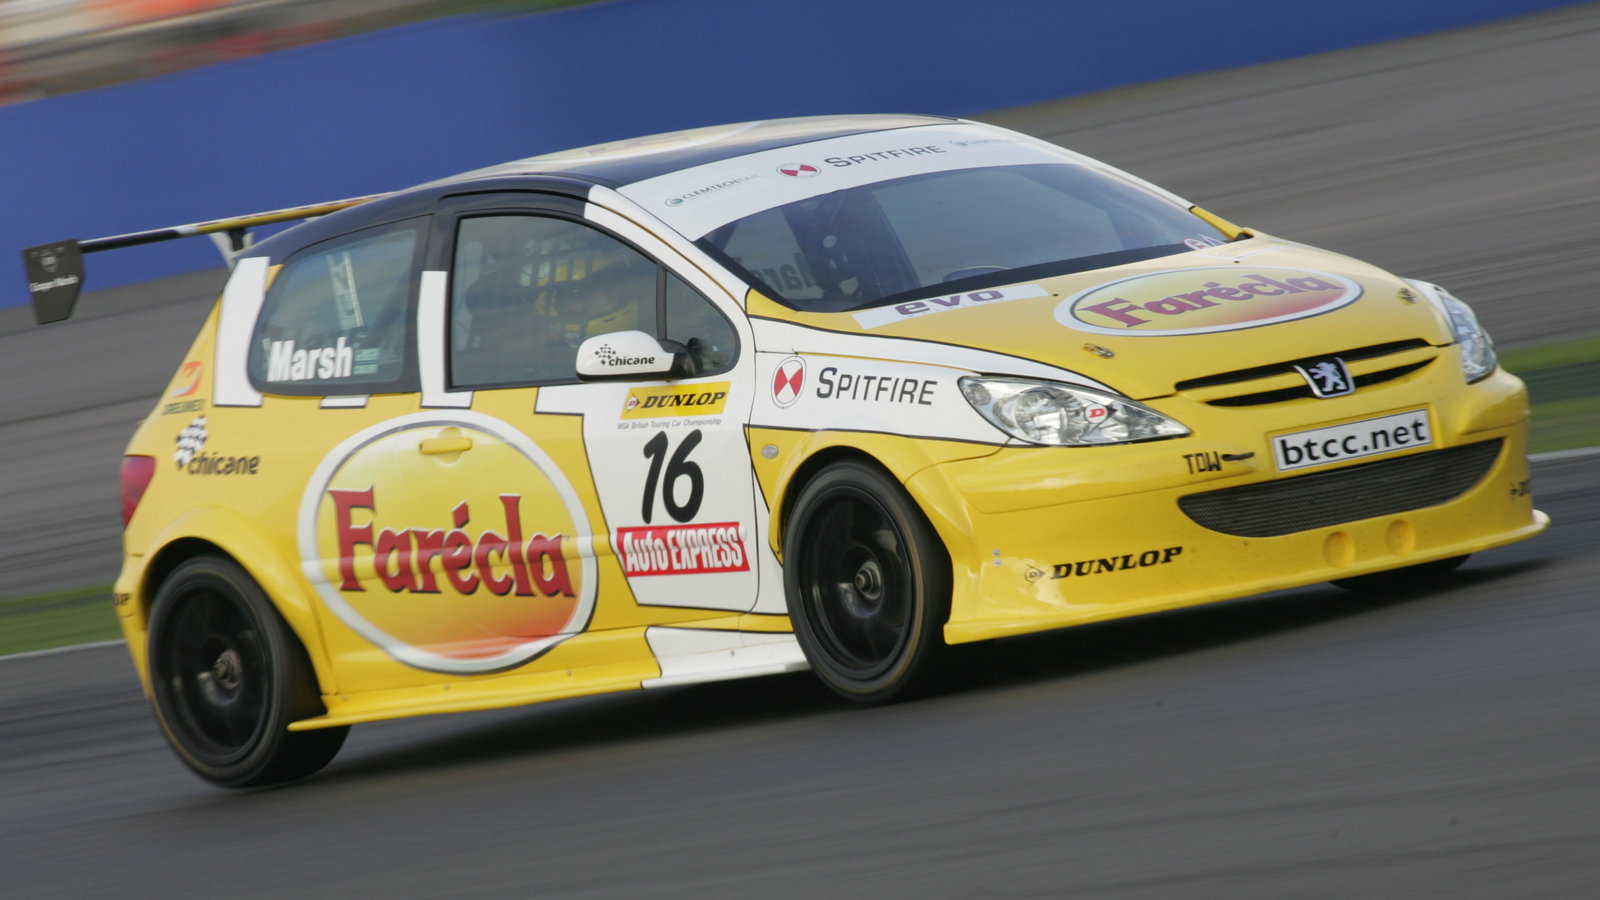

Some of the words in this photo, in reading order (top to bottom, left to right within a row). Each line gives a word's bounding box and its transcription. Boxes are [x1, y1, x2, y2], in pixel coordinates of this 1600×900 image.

[824, 145, 947, 168] SPITFIRE
[894, 288, 1005, 316] evo
[1077, 273, 1347, 328] Farécla
[266, 336, 353, 382] Marsh
[608, 356, 656, 367] chicane
[641, 391, 727, 409] DUNLOP
[816, 366, 939, 406] SPITFIRE
[631, 422, 649, 430] British
[650, 421, 670, 430] Touring
[683, 417, 722, 427] Championship
[1280, 418, 1428, 467] btcc.net
[188, 452, 261, 476] chicane
[642, 428, 705, 524] 16
[1183, 451, 1223, 475] TOW
[327, 484, 578, 598] Farécla
[623, 530, 669, 573] Auto
[667, 526, 744, 571] EXPRESS
[1050, 545, 1184, 580] DUNLOP
